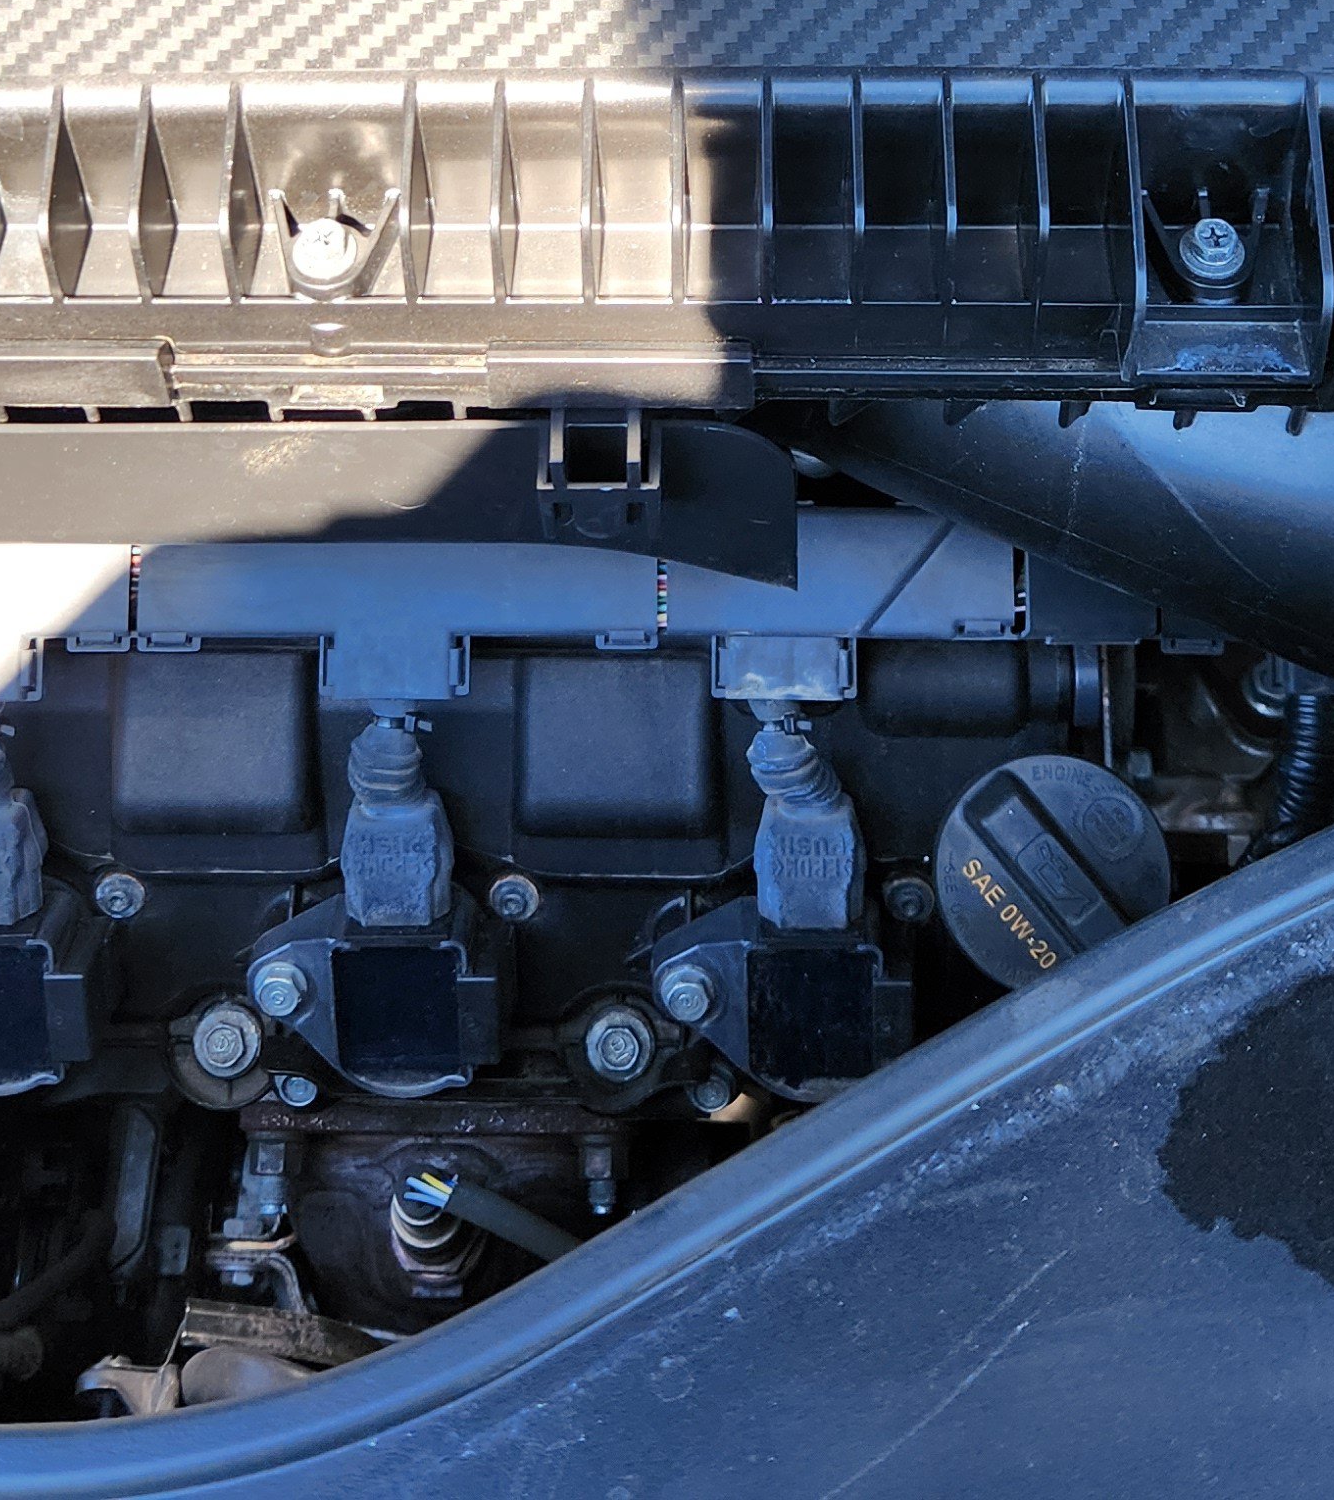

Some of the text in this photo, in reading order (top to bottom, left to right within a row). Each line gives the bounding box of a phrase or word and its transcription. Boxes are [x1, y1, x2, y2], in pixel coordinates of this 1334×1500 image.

[1032, 764, 1095, 788] ENGINE
[961, 859, 1007, 908] SAE
[1000, 904, 1057, 971] 0W-20
